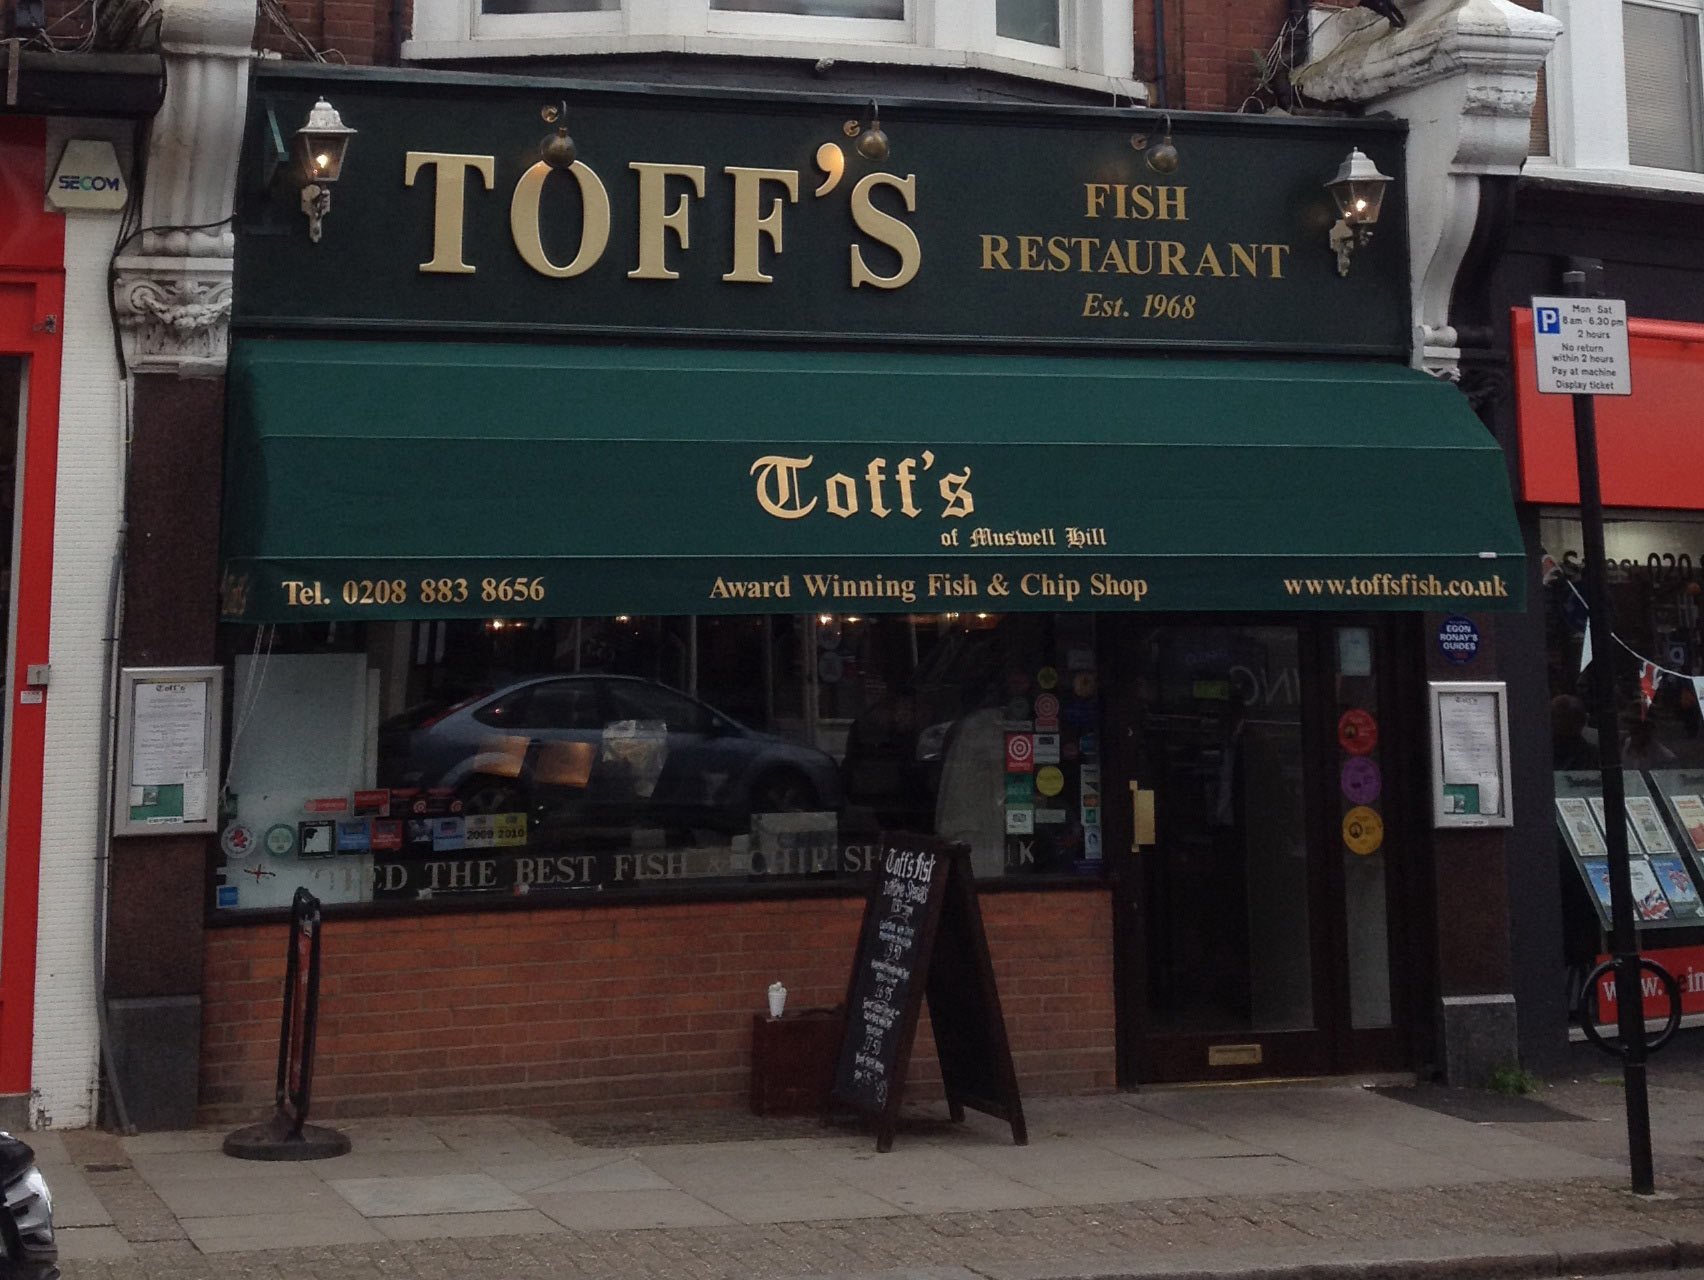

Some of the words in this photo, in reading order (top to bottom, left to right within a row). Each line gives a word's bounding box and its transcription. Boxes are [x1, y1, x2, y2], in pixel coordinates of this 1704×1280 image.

[58, 175, 120, 191] SECOM
[1083, 182, 1190, 222] FISH
[404, 142, 923, 290] TOFF'S
[979, 233, 1291, 281] RESTAURANT
[1081, 292, 1130, 319] Est.
[1141, 292, 1198, 321] 1968
[1572, 304, 1591, 313] Mon
[1597, 304, 1612, 314] Sat
[1577, 330, 1584, 338] 2
[1586, 330, 1611, 339] hours
[1561, 343, 1575, 352] No
[1577, 343, 1604, 353] return
[1552, 354, 1579, 363] within
[1581, 354, 1588, 363] 2
[1589, 355, 1614, 364] hours
[1552, 367, 1568, 377] Pay
[1570, 367, 1579, 376] at
[1581, 368, 1617, 377] machine
[1556, 379, 1587, 390] Display
[1589, 380, 1614, 390] ticket
[749, 449, 976, 520] Toff's
[940, 527, 959, 548] of
[970, 527, 1057, 549] Muswell
[1065, 526, 1108, 549] Hill
[281, 580, 331, 606] Tel.
[341, 579, 407, 605] 0208
[420, 578, 469, 603] 883
[481, 575, 545, 602] 8656
[709, 574, 791, 599] Award
[802, 574, 917, 604] Winning
[927, 572, 978, 597] Fish
[987, 574, 1010, 596] &
[1020, 573, 1081, 602] Chip
[1090, 573, 1149, 602] Shop
[1283, 573, 1509, 598] www.toffsfish.co.uk
[1439, 633, 1479, 642] RONAY'S
[1446, 624, 1472, 633] EGON
[1442, 641, 1477, 651] GUIDES
[424, 859, 498, 889] THE
[513, 855, 598, 886] BEST
[613, 852, 688, 882] FISH
